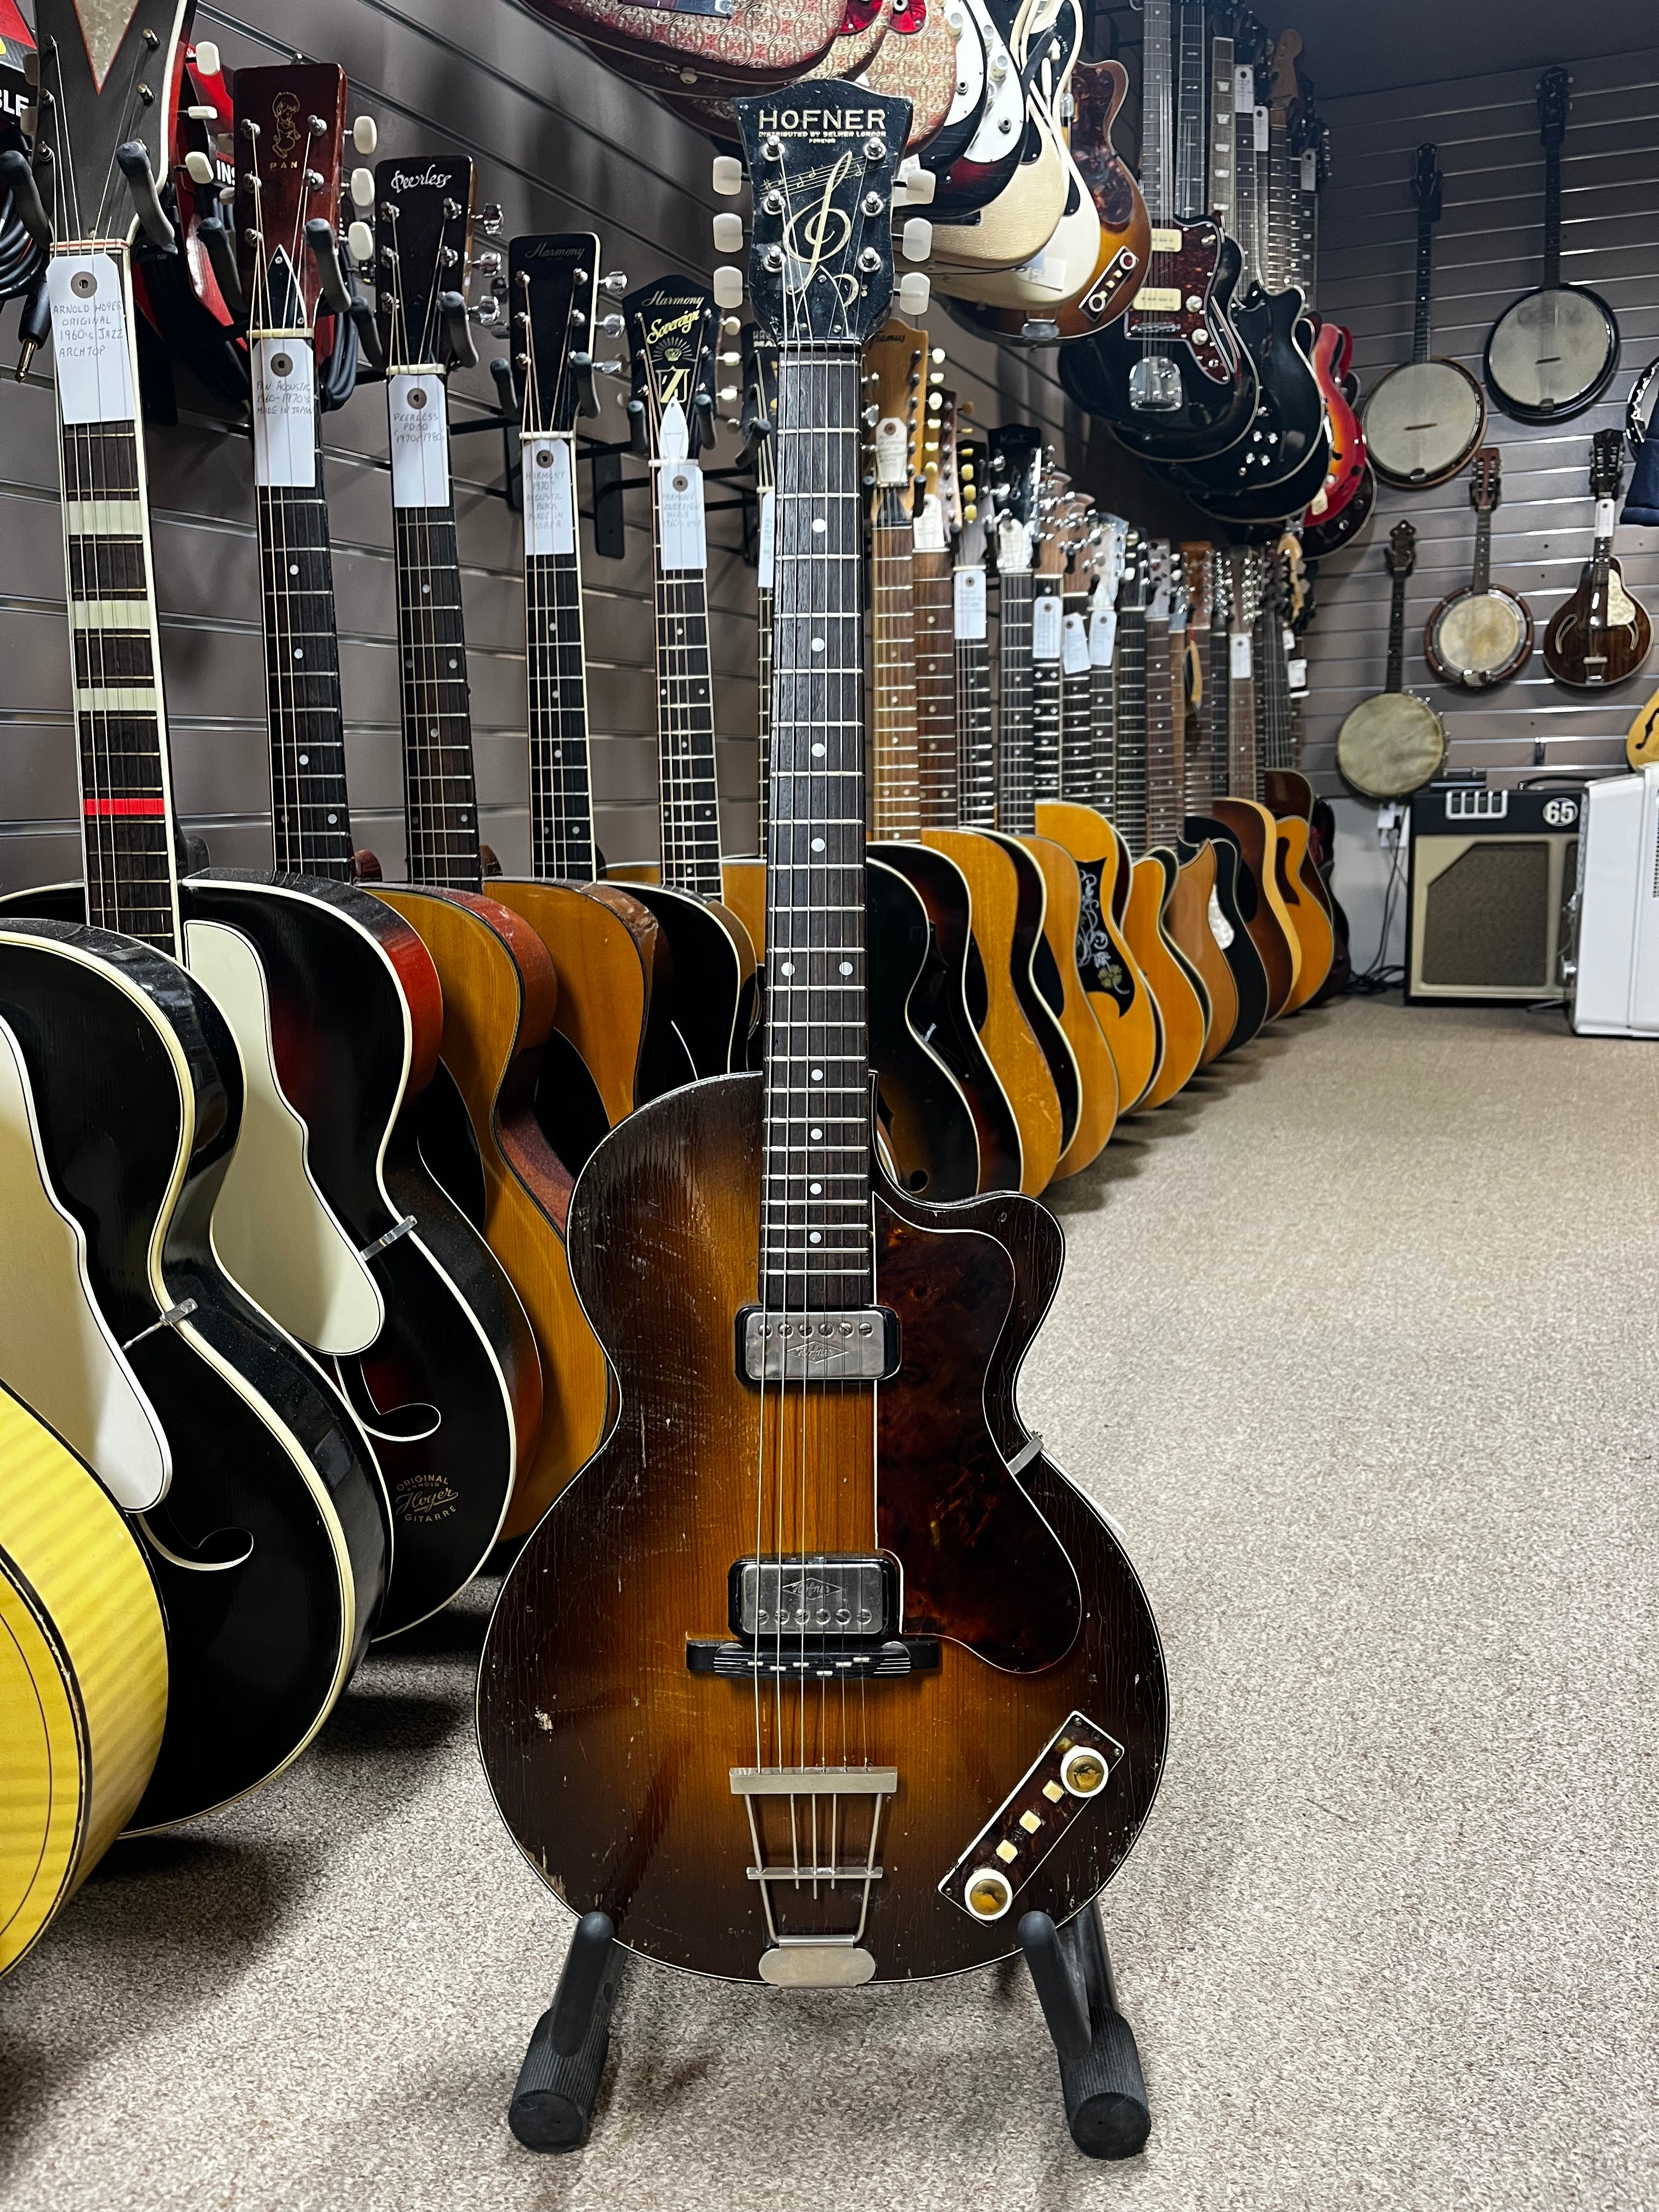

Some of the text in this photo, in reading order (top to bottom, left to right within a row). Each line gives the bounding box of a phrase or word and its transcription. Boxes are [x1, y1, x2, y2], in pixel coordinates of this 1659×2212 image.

[759, 109, 885, 129] HOFNER
[269, 161, 297, 171] PAN
[391, 163, 452, 194] Peerless
[524, 241, 585, 261] Harmony
[53, 304, 89, 314] ARNOLD
[641, 290, 704, 309] Harmony
[62, 316, 111, 326] ORIGINAL
[646, 309, 700, 345] Sovereign
[60, 328, 123, 341] 1960's JAZZ
[1547, 802, 1574, 823] 65
[396, 1474, 449, 1491] ORIGINAL
[395, 1487, 459, 1515] Hoyer
[404, 1505, 456, 1522] GITARRE
